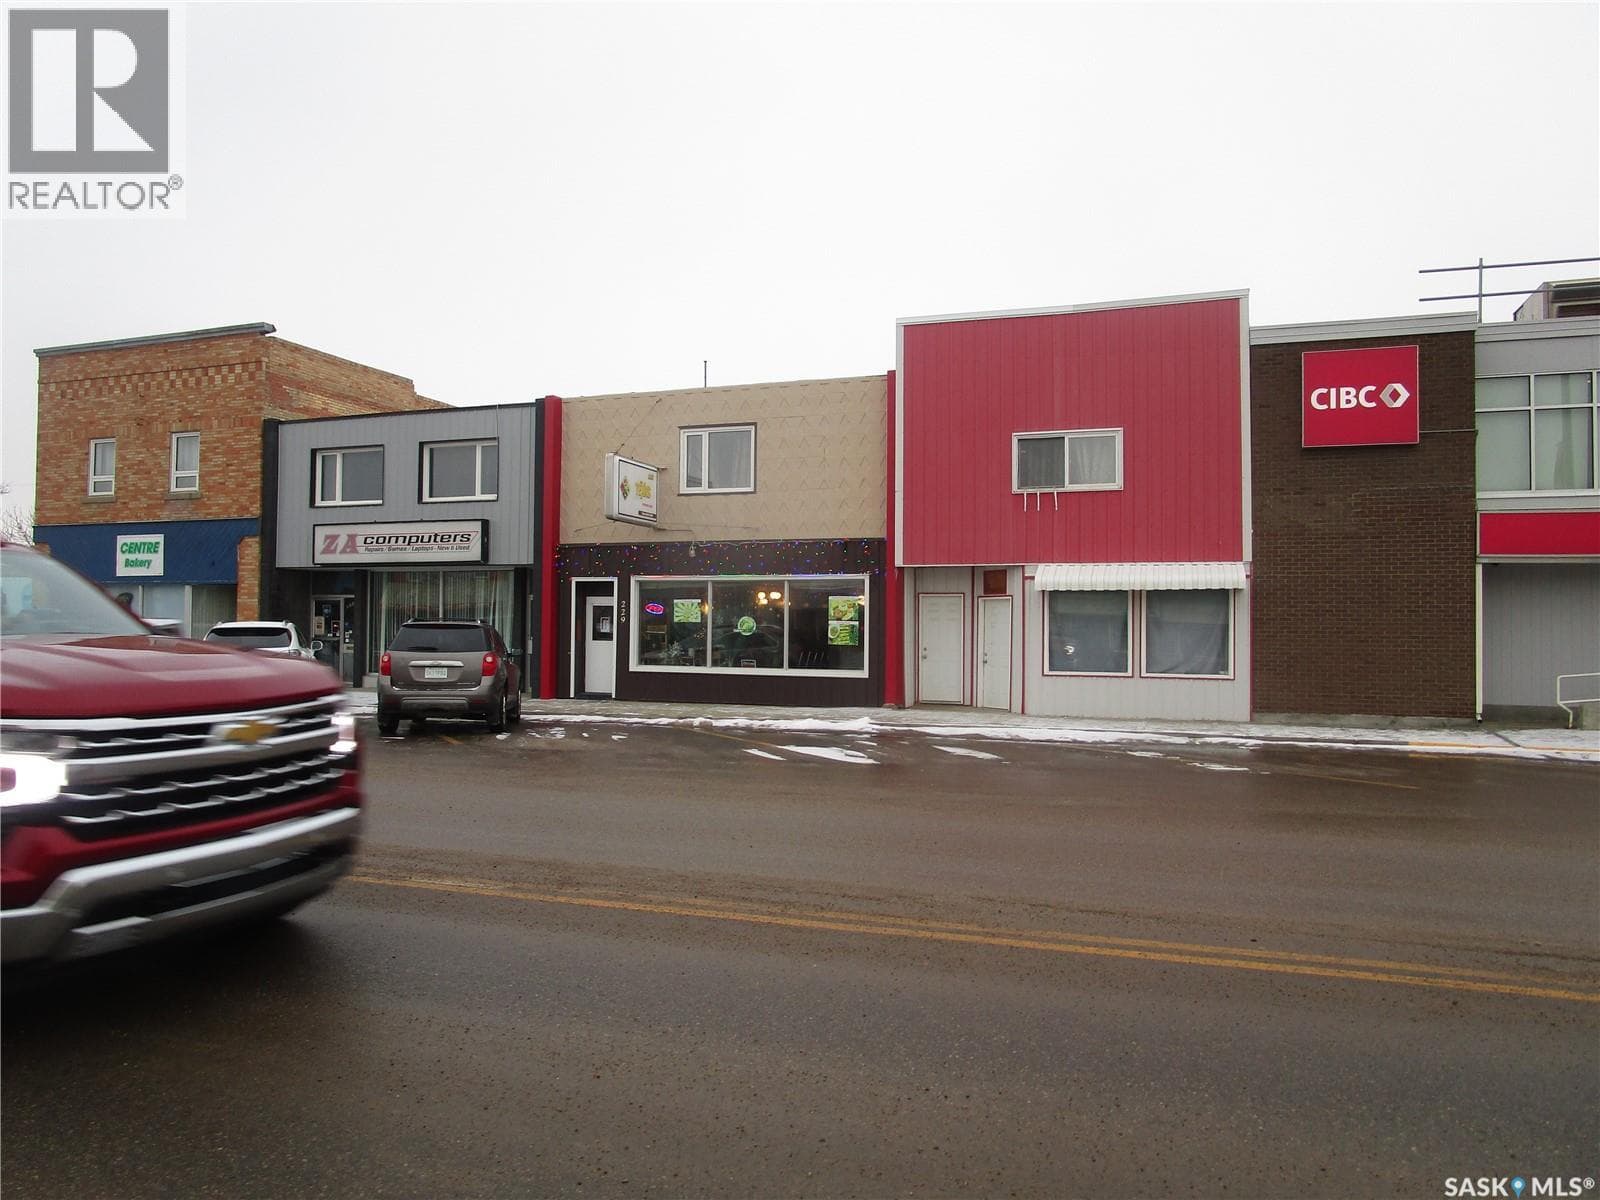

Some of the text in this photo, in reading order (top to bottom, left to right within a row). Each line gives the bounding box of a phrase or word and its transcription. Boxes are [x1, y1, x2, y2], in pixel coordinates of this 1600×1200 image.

[1310, 385, 1377, 410] CIBC
[363, 533, 471, 546] computers
[120, 541, 160, 554] CENTRE
[124, 558, 152, 569] Bakery
